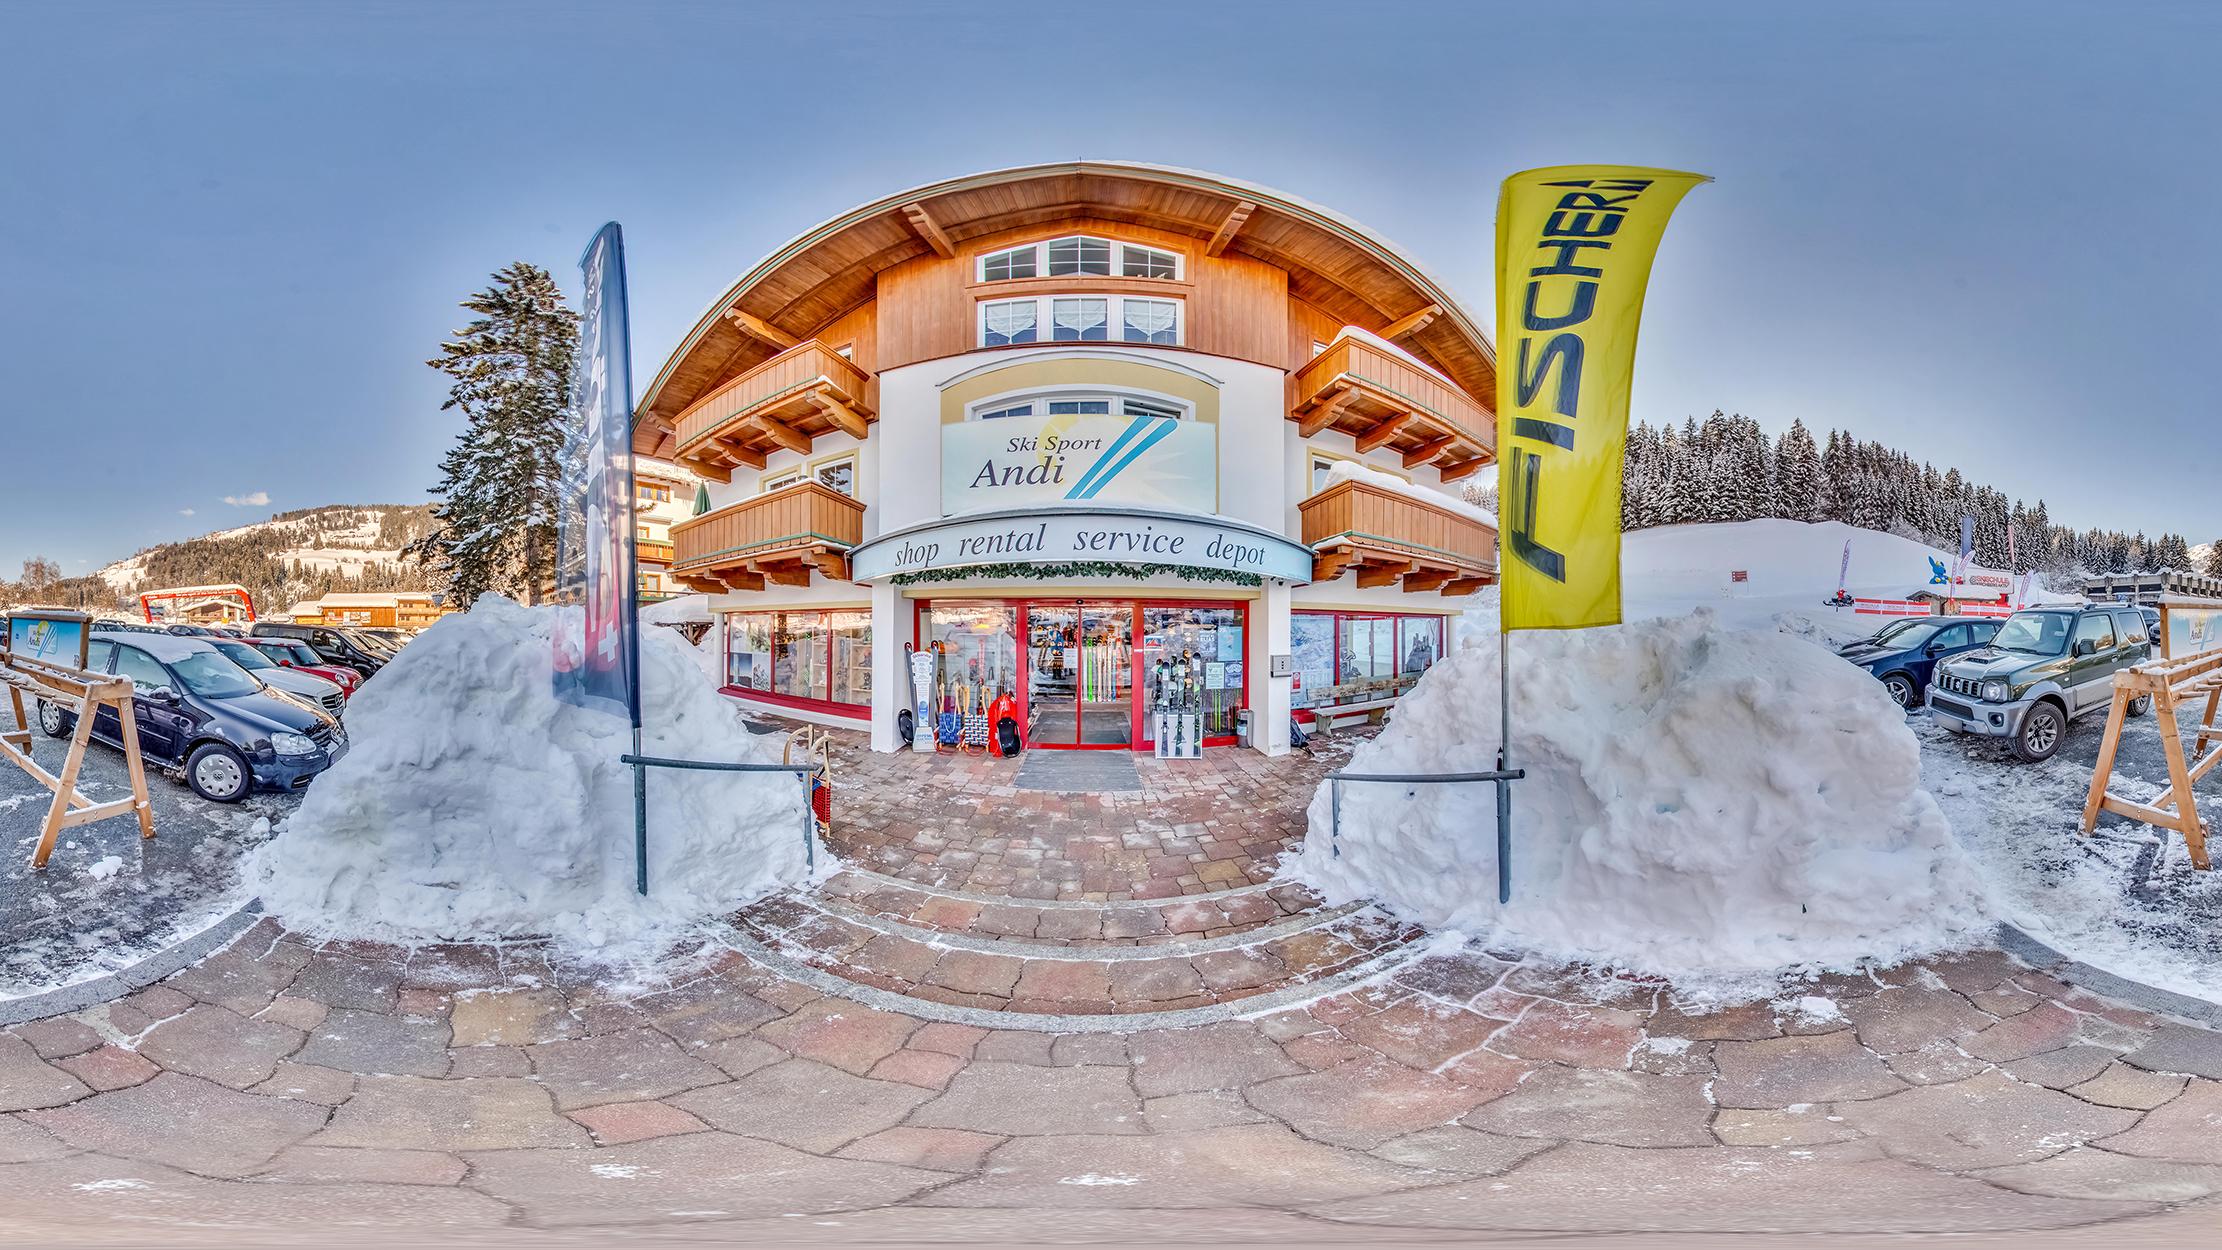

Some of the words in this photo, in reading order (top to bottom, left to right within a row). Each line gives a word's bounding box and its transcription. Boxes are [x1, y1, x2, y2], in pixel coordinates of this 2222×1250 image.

[1507, 191, 1643, 584] FISCHER
[1007, 437, 1038, 453] Ski
[1045, 436, 1102, 454] Sport
[969, 455, 1065, 488] Andi
[895, 541, 939, 567] shop
[959, 523, 1046, 556] rental
[1073, 526, 1185, 554] service
[1206, 534, 1266, 567] depot
